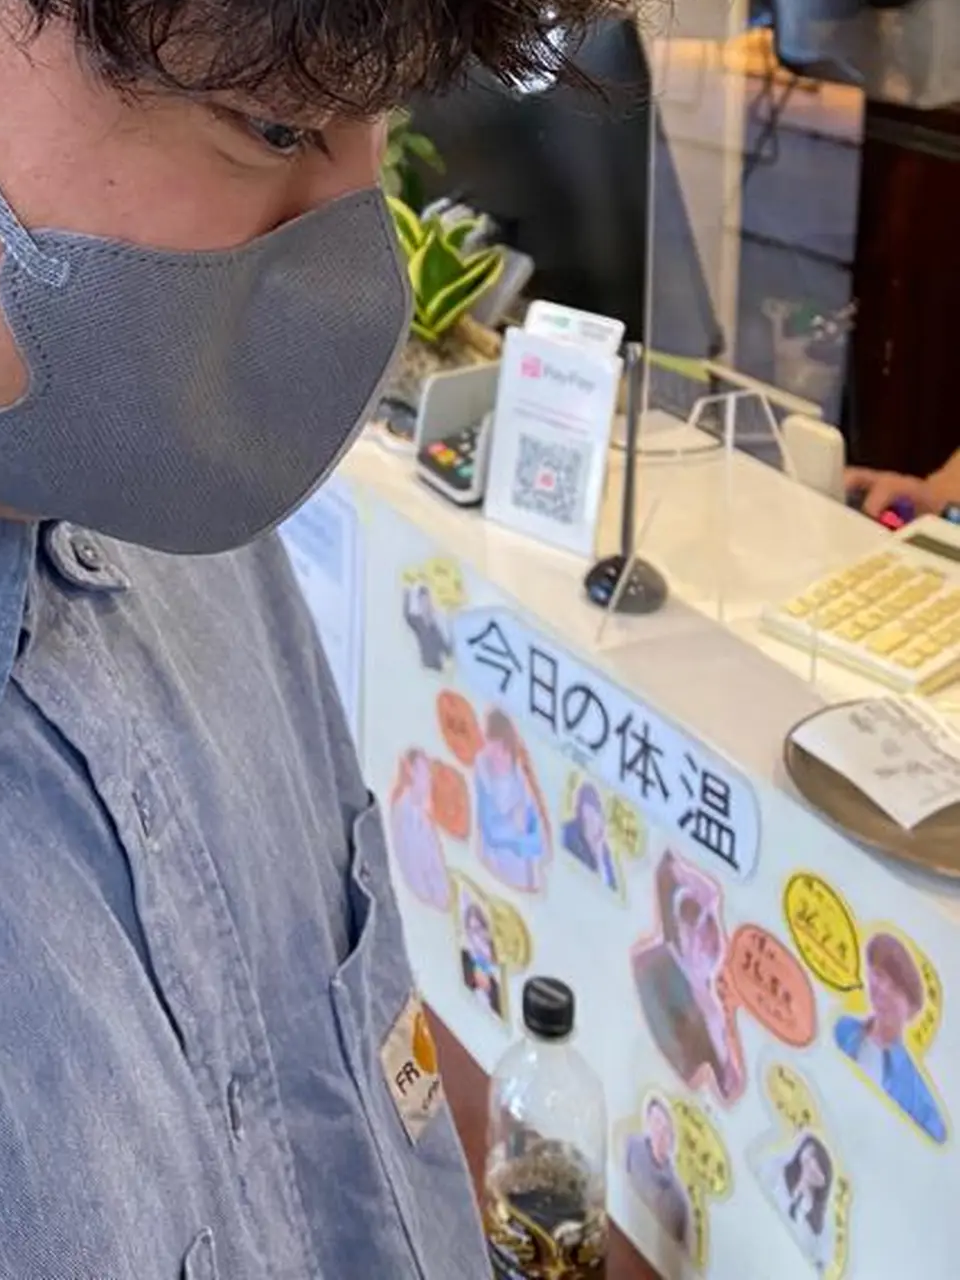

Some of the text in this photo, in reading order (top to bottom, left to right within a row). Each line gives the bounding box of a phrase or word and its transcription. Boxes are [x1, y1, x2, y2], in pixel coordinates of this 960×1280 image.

[467, 620, 740, 871] 今日の体温
